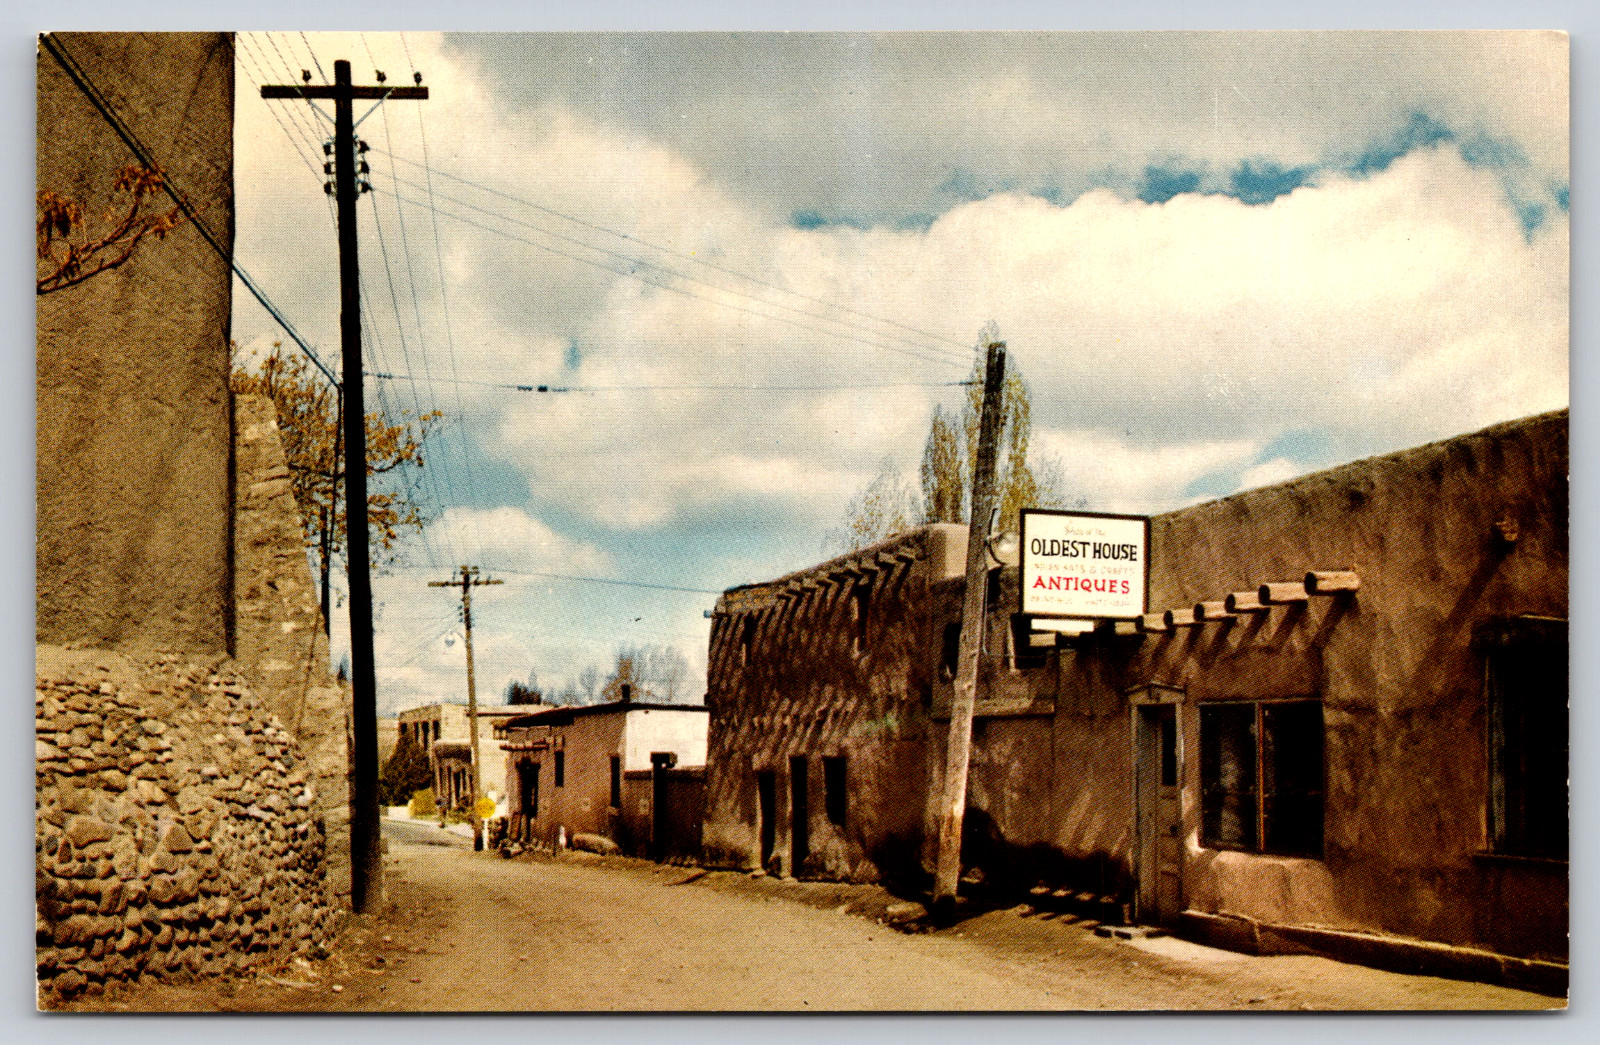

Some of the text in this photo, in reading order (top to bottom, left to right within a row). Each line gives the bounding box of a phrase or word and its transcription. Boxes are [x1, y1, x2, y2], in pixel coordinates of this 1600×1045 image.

[1031, 538, 1137, 561] OLDEST HOUSE
[1032, 575, 1130, 594] ANTIQUES
